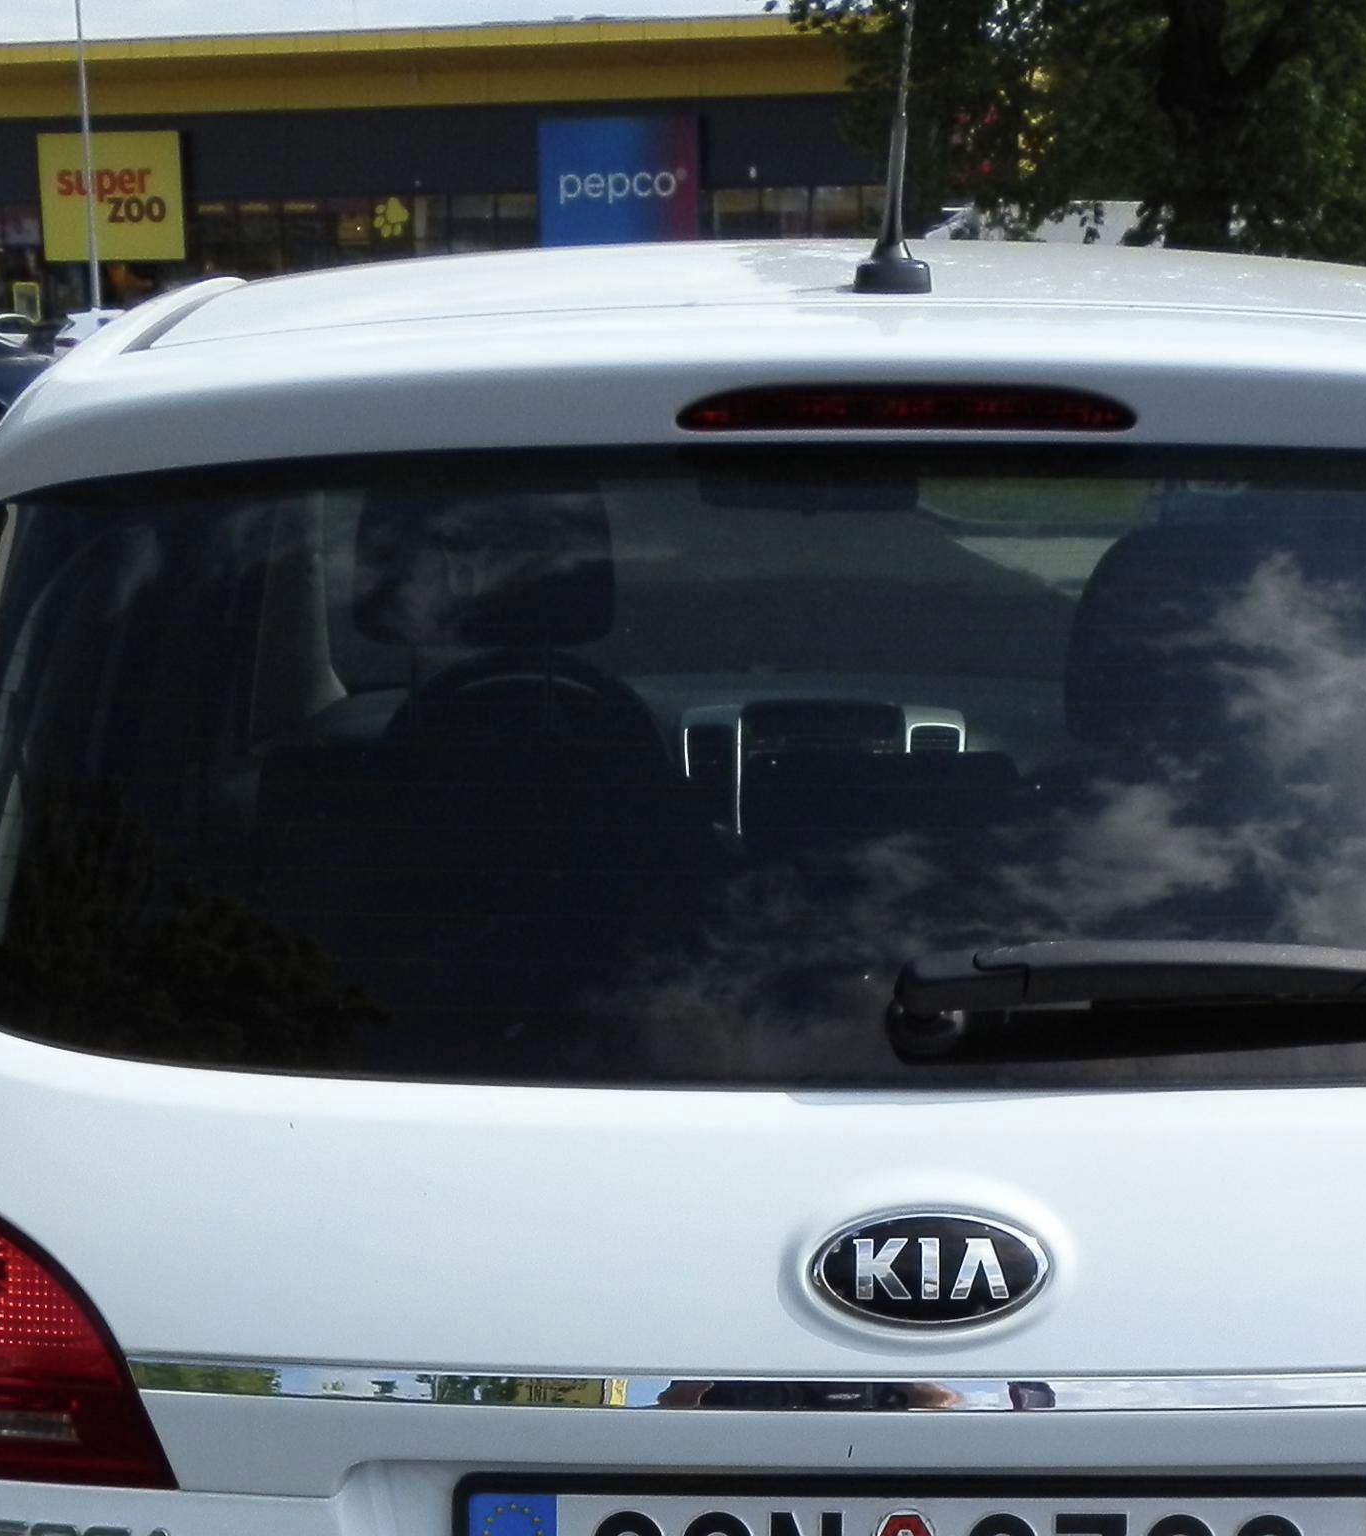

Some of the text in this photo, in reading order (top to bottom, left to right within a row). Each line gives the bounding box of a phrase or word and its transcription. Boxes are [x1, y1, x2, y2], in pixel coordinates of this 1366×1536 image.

[57, 167, 153, 203] super
[107, 195, 166, 223] zoo
[853, 1237, 1010, 1300] KIA
